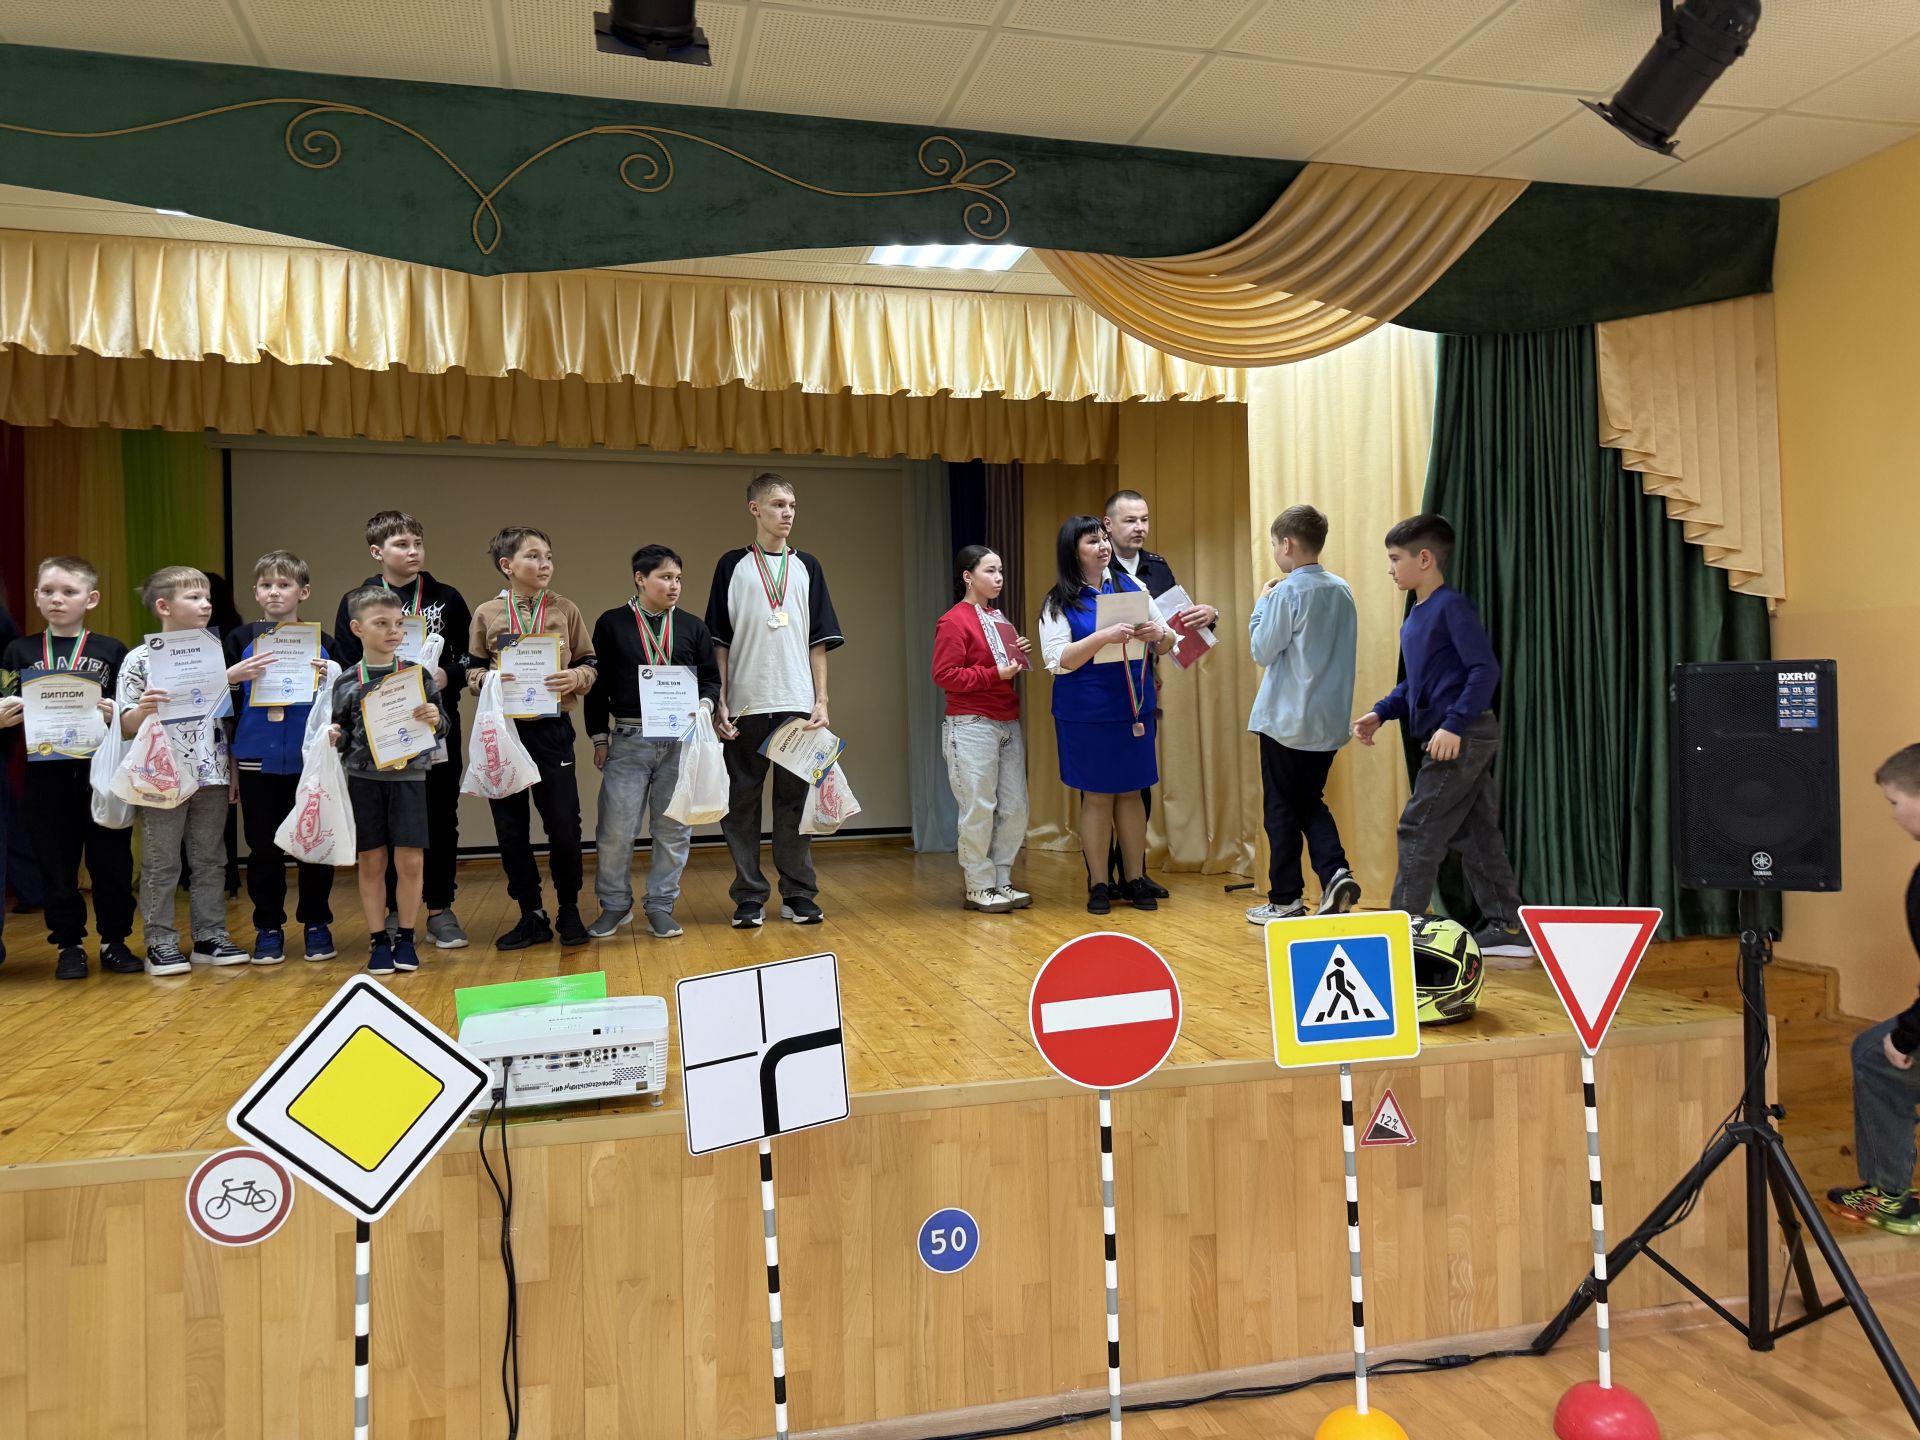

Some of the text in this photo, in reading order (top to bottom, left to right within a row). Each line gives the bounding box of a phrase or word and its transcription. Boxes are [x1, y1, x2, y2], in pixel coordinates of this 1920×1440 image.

[170, 647, 201, 656] Диплом
[1778, 672, 1817, 681] DXR10
[41, 691, 84, 699] ДИПЛОМ
[1380, 1113, 1399, 1131] 12%
[931, 1226, 967, 1255] 50
